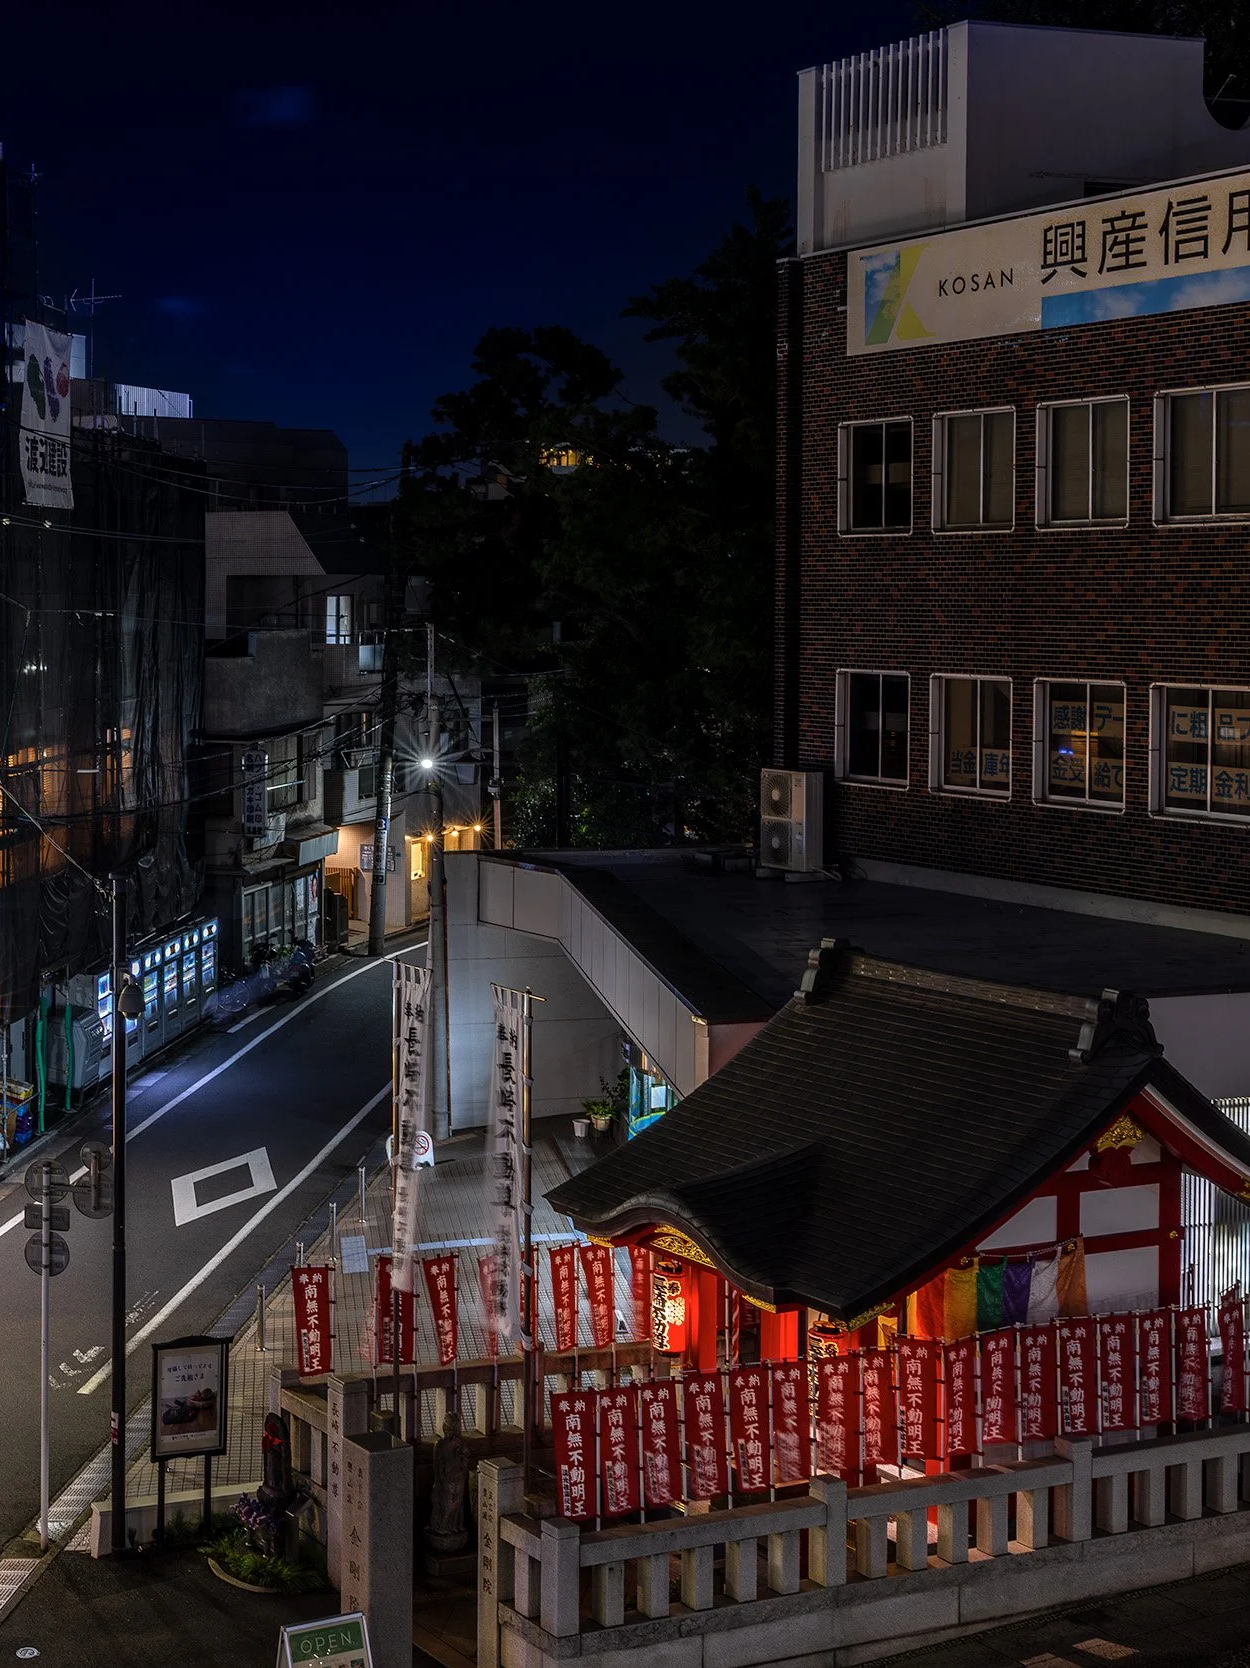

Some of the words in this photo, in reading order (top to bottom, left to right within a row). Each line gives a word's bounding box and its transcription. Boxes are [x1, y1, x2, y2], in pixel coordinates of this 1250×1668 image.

[1041, 188, 1250, 285] 興産信用
[938, 267, 1014, 297] KOSAN
[1052, 704, 1123, 731] 感謝デー
[246, 753, 255, 824] 名刺・ガキ印刷
[254, 753, 263, 823] ハン・ゴム印
[554, 1252, 571, 1265] 奉納
[586, 1249, 606, 1261] 奉納
[430, 1263, 450, 1276] 奉納
[299, 1273, 323, 1285] 奉納
[1101, 1323, 1126, 1334] 奉納
[1143, 1317, 1164, 1331] 奉納
[1060, 1326, 1087, 1338] 奉納
[987, 1337, 1008, 1351] 奉納
[1025, 1335, 1048, 1346] 奉納
[900, 1345, 928, 1359] 奉納
[948, 1347, 968, 1361] 奉納
[774, 1368, 801, 1381] 奉納
[823, 1362, 849, 1375] 奉納
[689, 1381, 716, 1395] 奉納
[734, 1374, 761, 1388] 奉納
[1066, 1340, 1087, 1432] 南無不動明王
[1107, 1335, 1125, 1427] 南無不動明王
[600, 1394, 628, 1408] 奉納
[642, 1388, 670, 1401] 奉納
[559, 1399, 586, 1412] 奉納
[905, 1359, 925, 1456] 南無不動明王
[740, 1388, 767, 1489] 南無不動明王
[780, 1382, 804, 1481] 南無不
[330, 1402, 340, 1499] 長崎不動尊
[565, 1414, 587, 1516] 南無不動明王
[348, 1525, 361, 1612] 金剛院
[482, 1532, 493, 1596] 金剛院
[300, 1631, 351, 1653] OPEN
